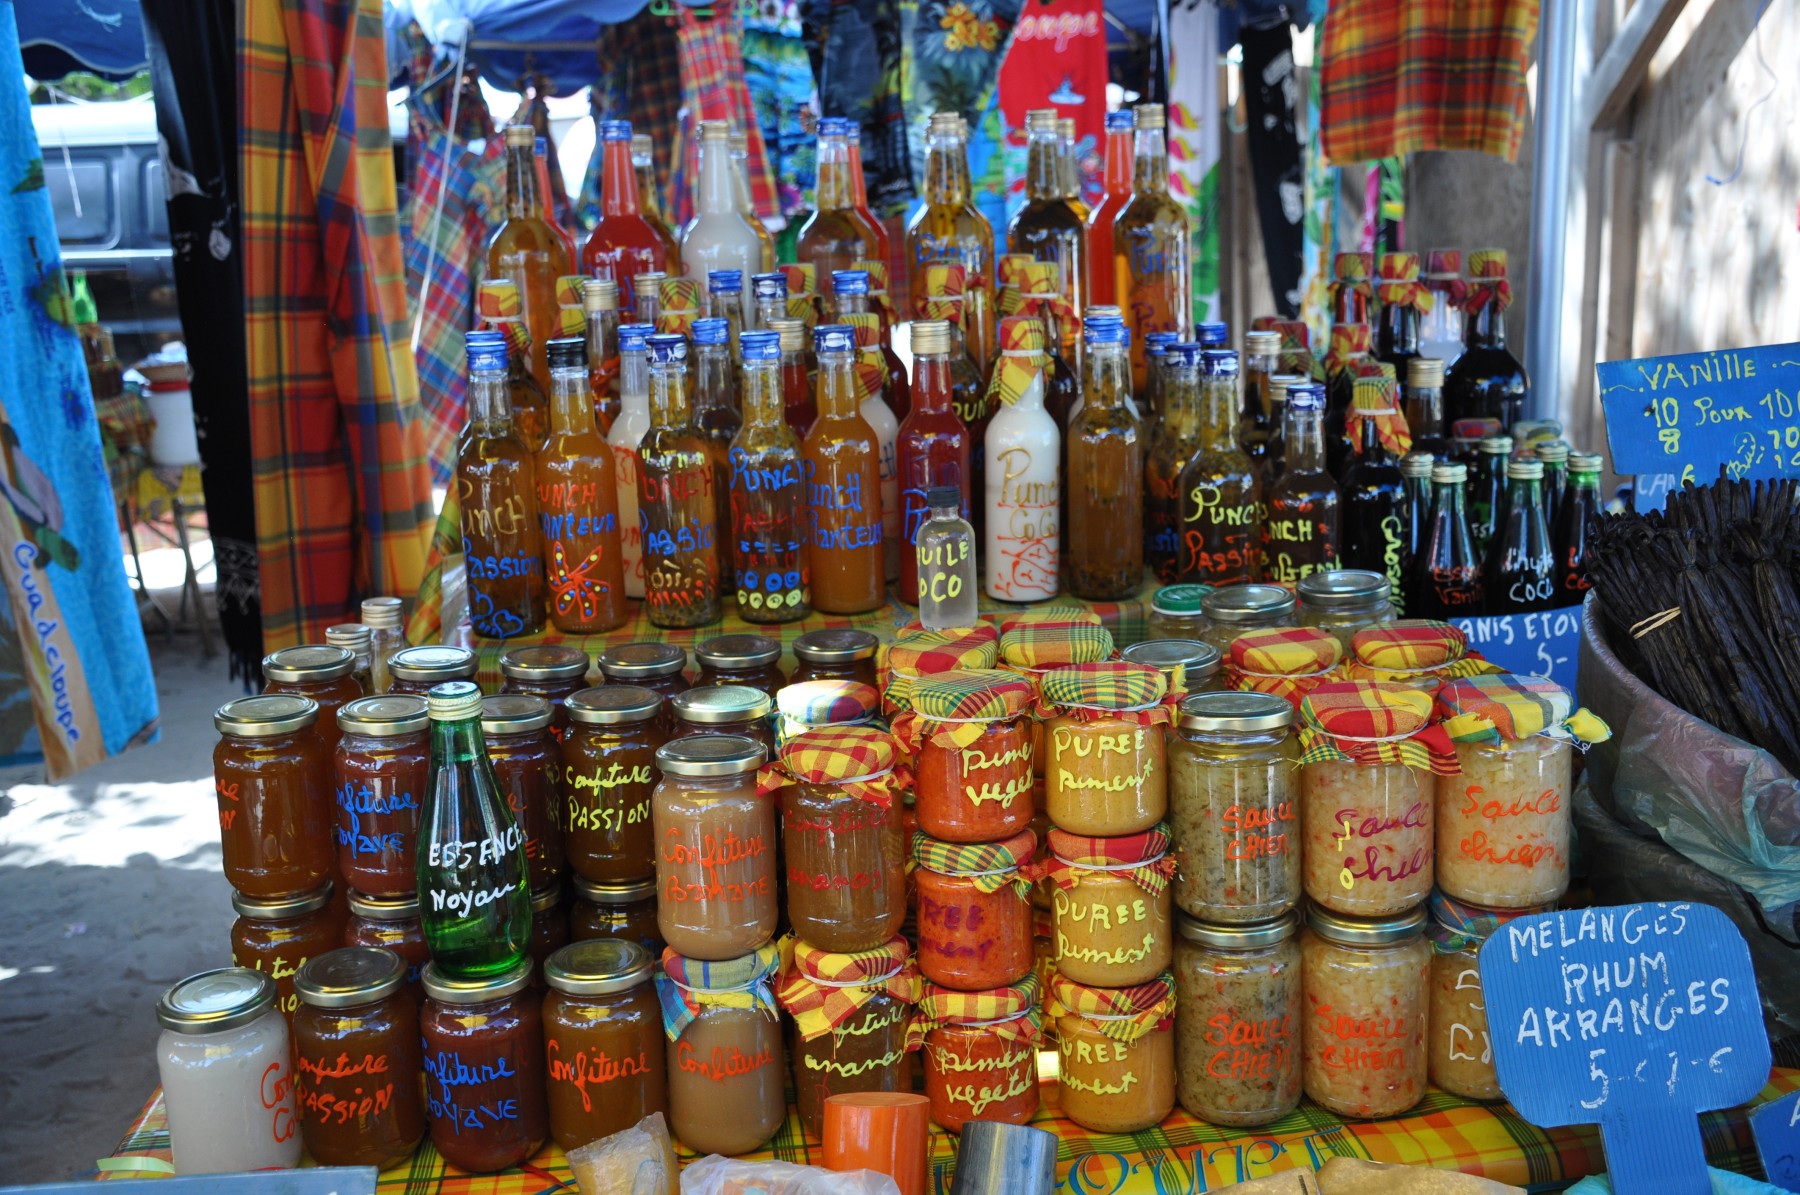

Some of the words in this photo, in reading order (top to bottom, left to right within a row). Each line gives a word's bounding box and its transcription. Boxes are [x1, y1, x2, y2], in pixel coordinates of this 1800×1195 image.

[1658, 428, 1682, 455] 8
[1053, 726, 1146, 762] PUREE
[1053, 887, 1147, 934] PUREE
[1508, 901, 1691, 964] MELANGES
[1516, 977, 1731, 1048] ARRANGES
